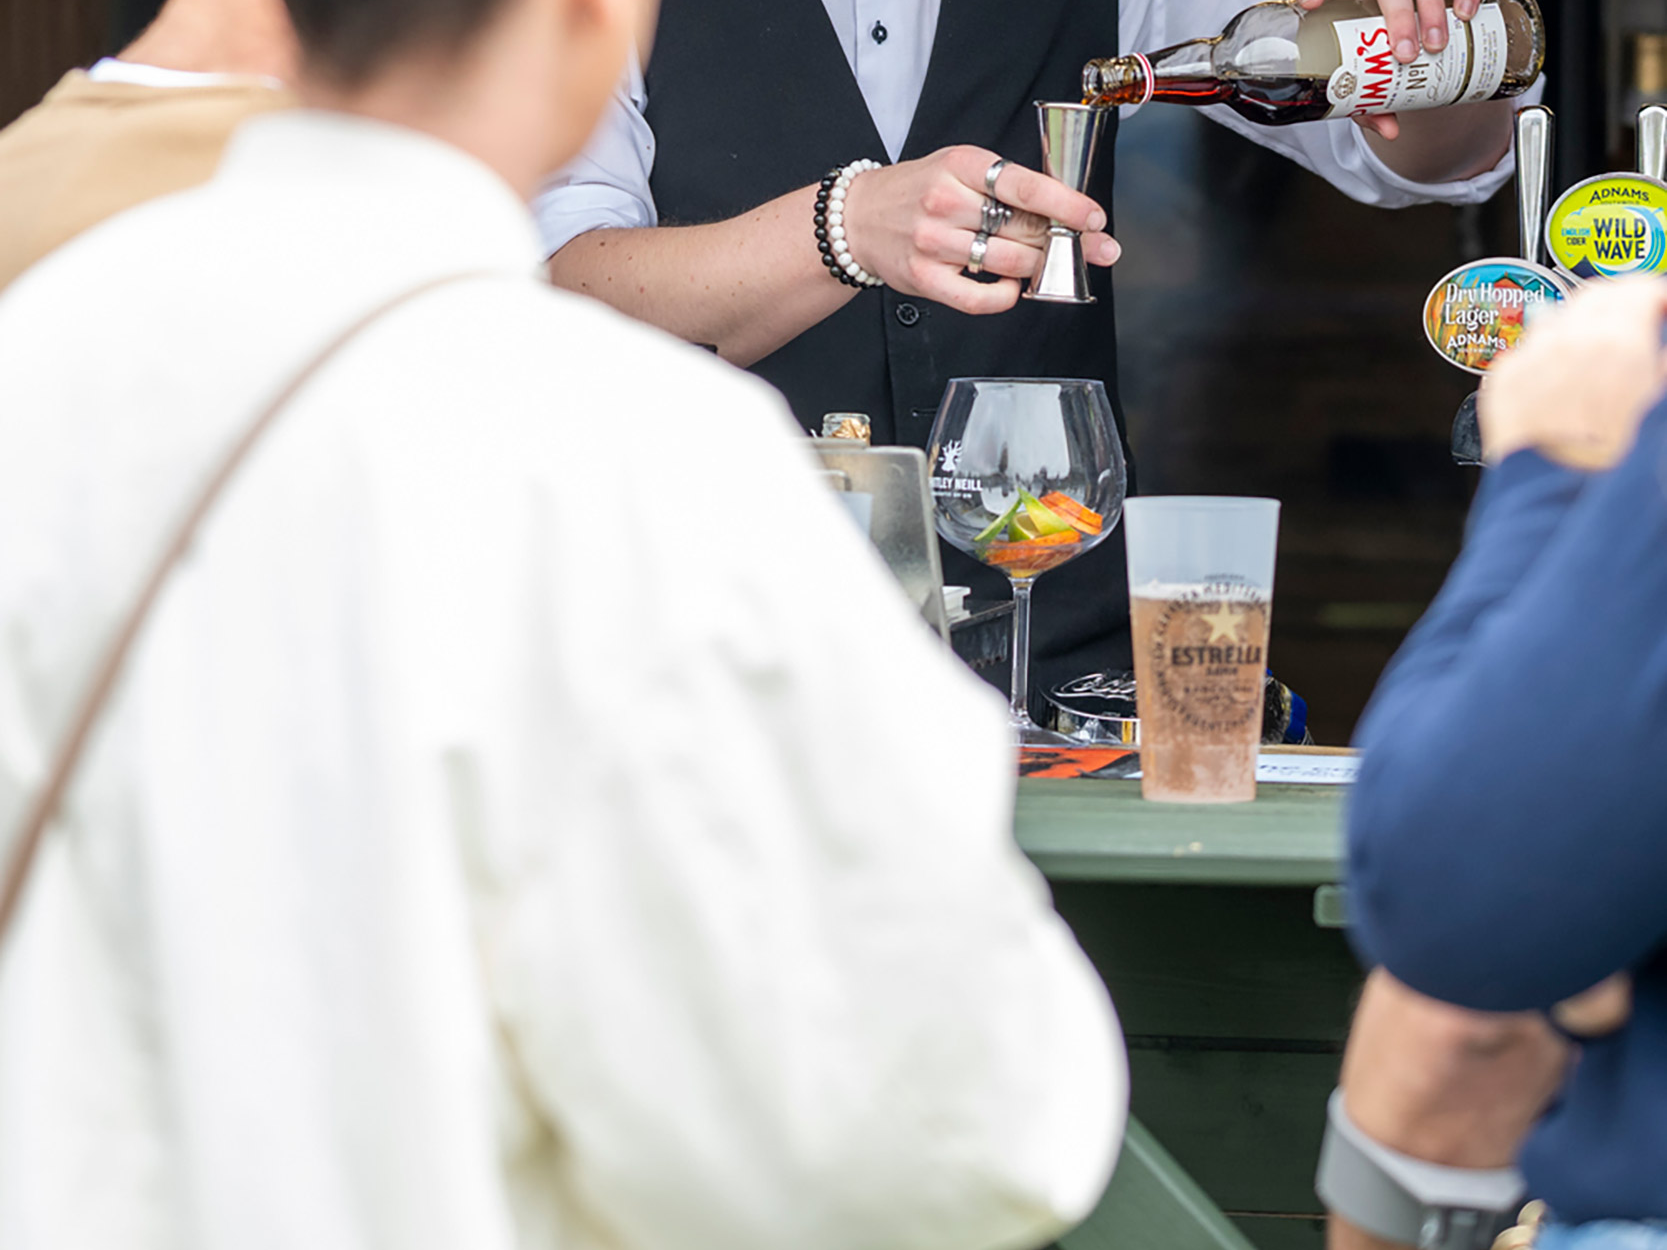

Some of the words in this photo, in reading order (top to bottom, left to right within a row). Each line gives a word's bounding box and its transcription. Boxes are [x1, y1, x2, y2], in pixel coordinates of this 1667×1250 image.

[1589, 187, 1650, 204] ADNAMS
[1593, 218, 1647, 238] WILD
[1566, 237, 1586, 245] CIDER
[1593, 240, 1646, 259] WAVE
[1445, 283, 1477, 308] Dry
[1480, 282, 1545, 308] Hopped
[1445, 303, 1499, 331] Lager
[1446, 333, 1507, 350] ADNAMS
[953, 478, 983, 491] NEILL
